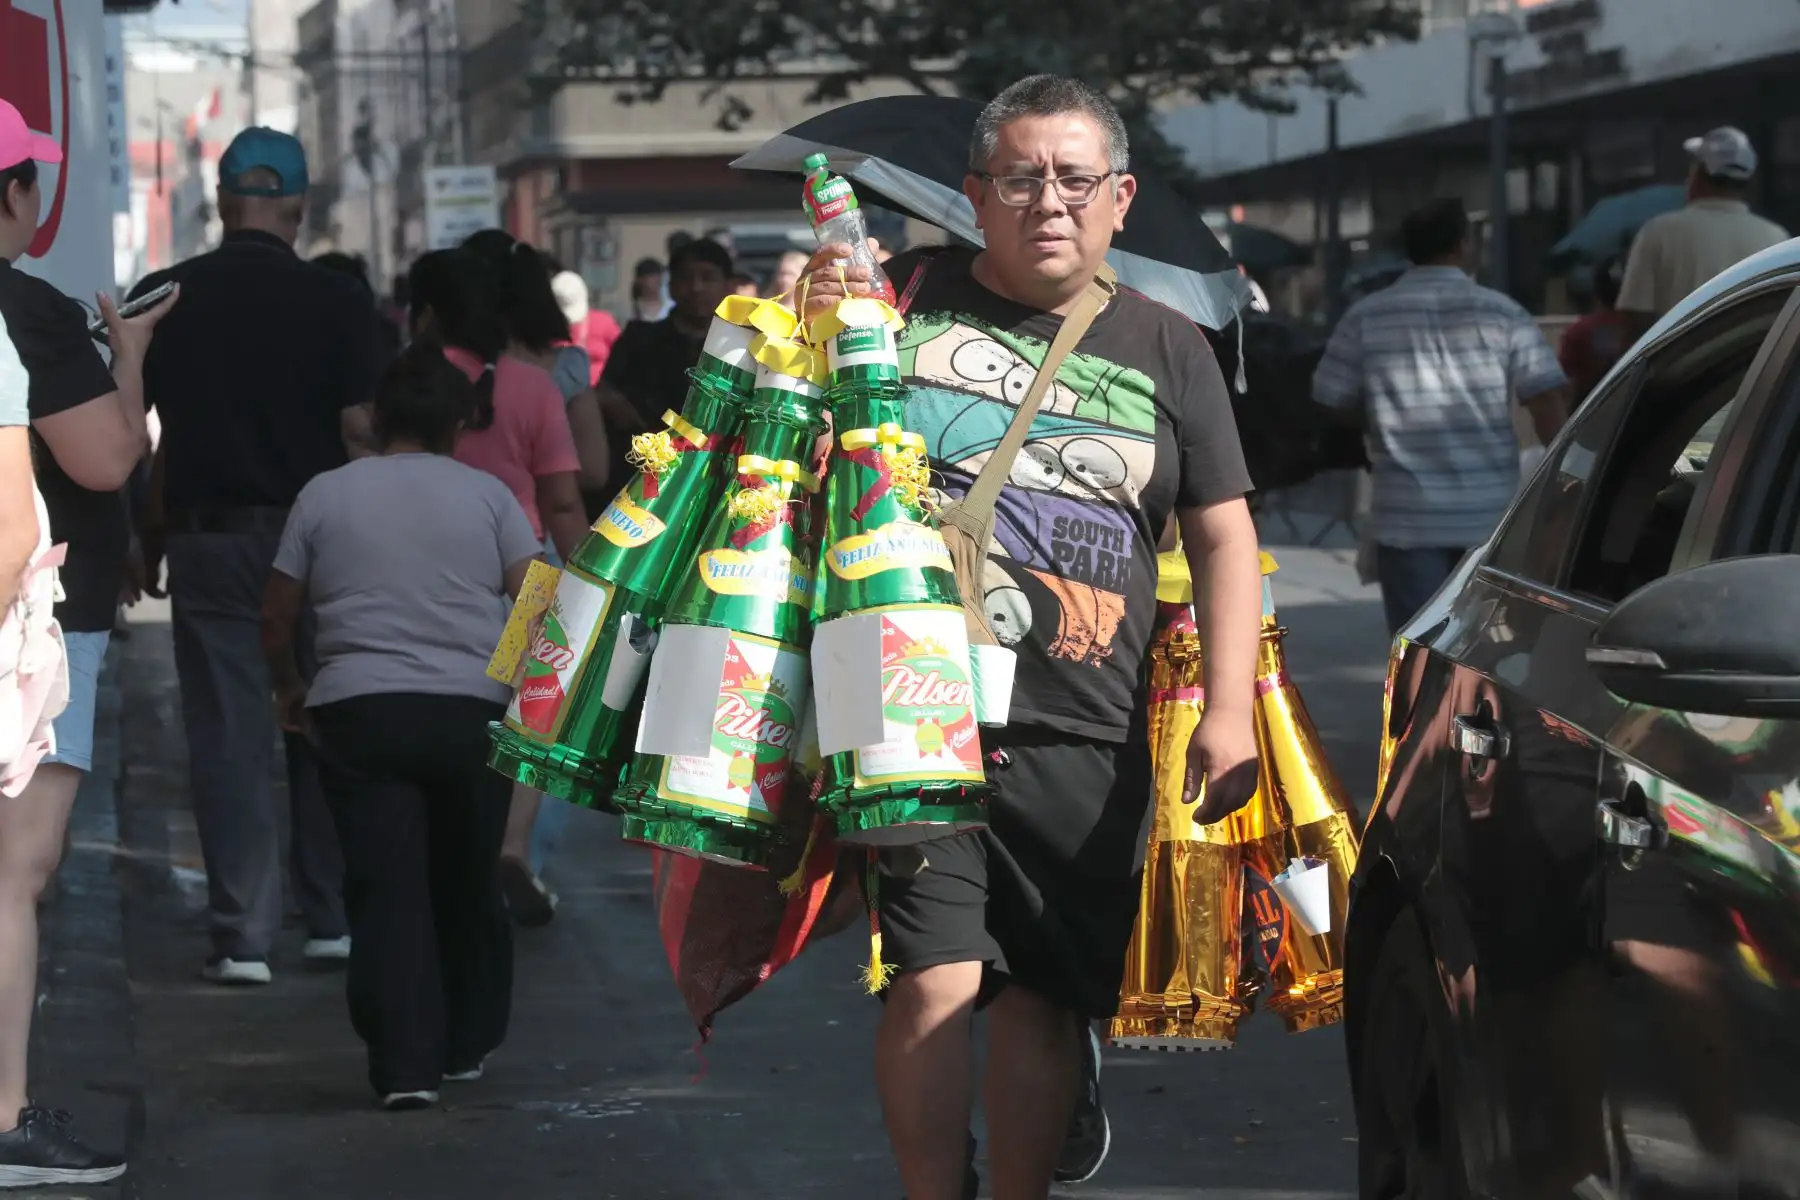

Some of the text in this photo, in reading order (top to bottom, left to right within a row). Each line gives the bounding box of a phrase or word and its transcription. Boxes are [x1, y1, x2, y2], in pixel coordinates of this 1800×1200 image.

[1052, 515, 1125, 554] SOUTH
[711, 563, 756, 579] FELIZ
[840, 543, 880, 569] FELIZ
[1050, 540, 1131, 593] PARK
[880, 663, 977, 708] Pilsen
